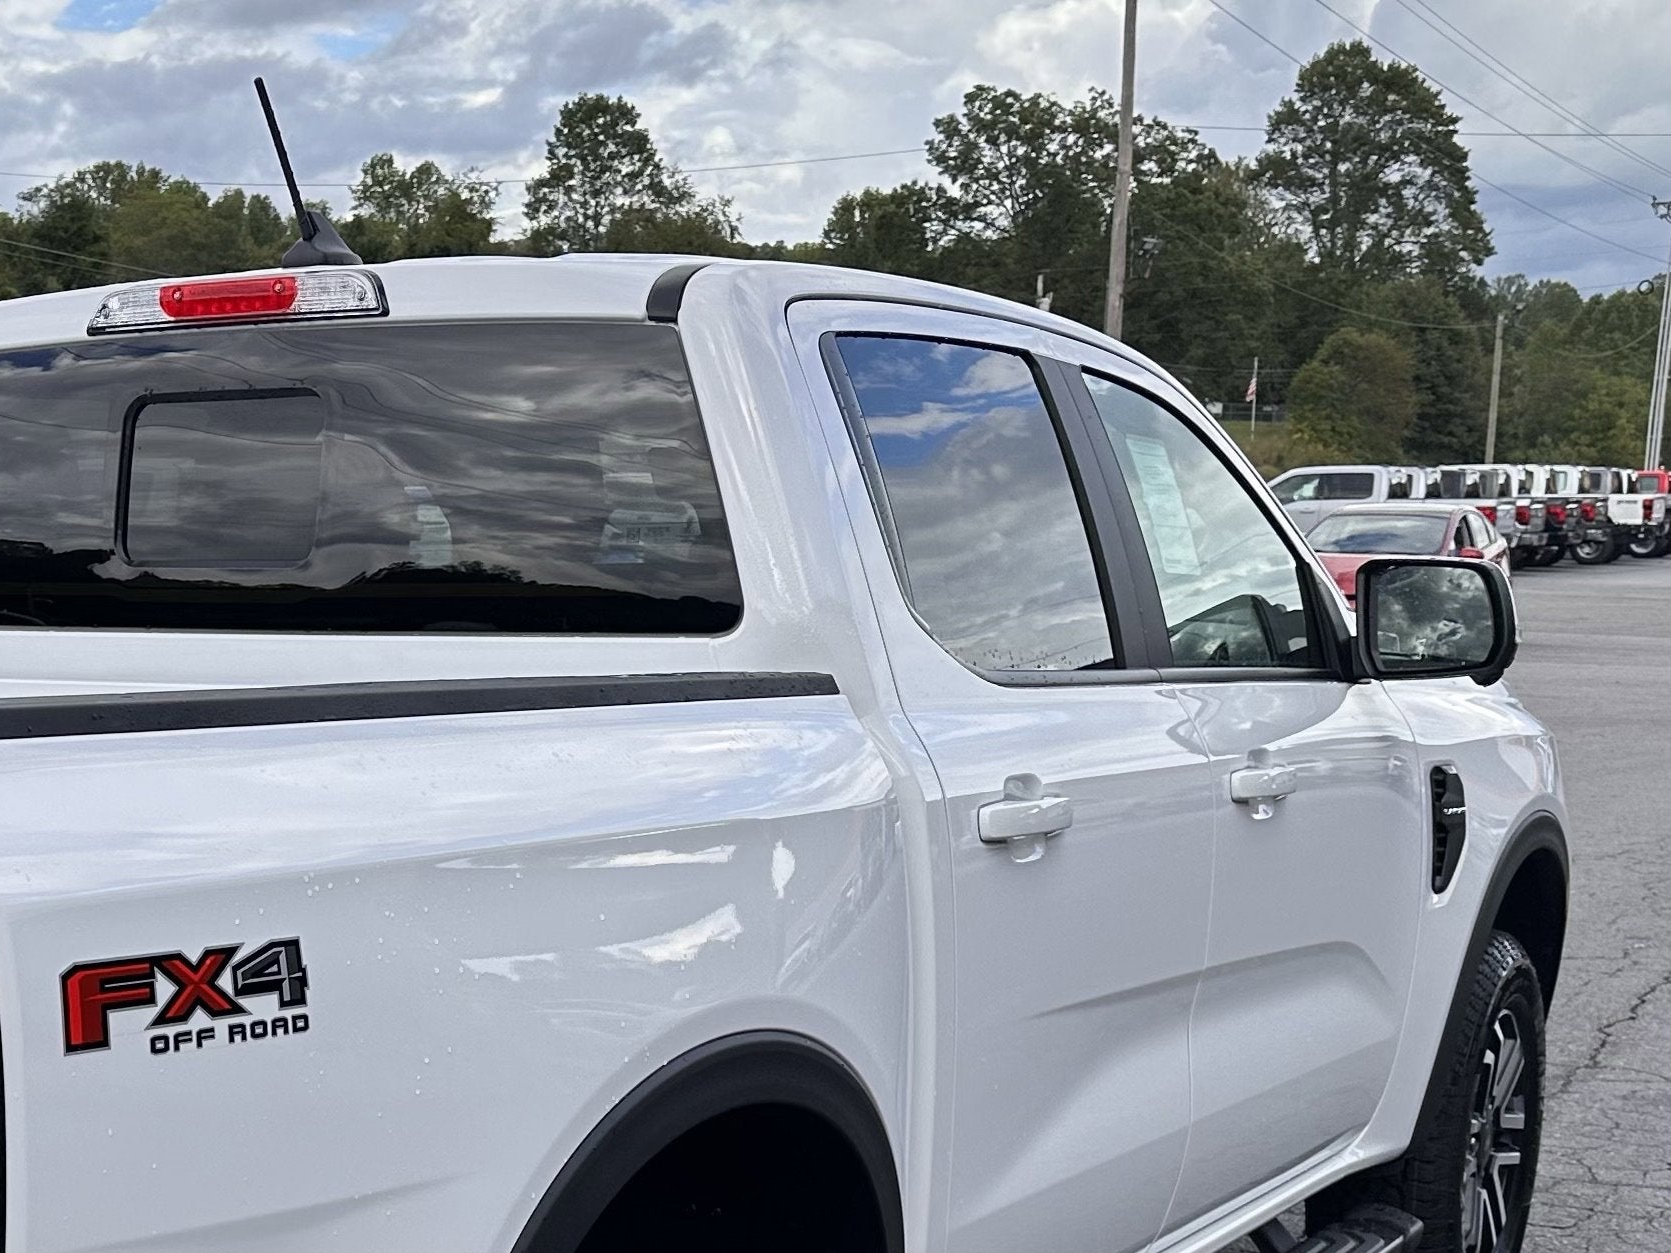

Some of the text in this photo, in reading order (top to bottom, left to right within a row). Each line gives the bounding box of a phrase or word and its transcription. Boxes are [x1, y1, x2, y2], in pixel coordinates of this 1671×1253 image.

[59, 936, 310, 1056] FX4
[149, 1012, 311, 1055] OFF ROAD
